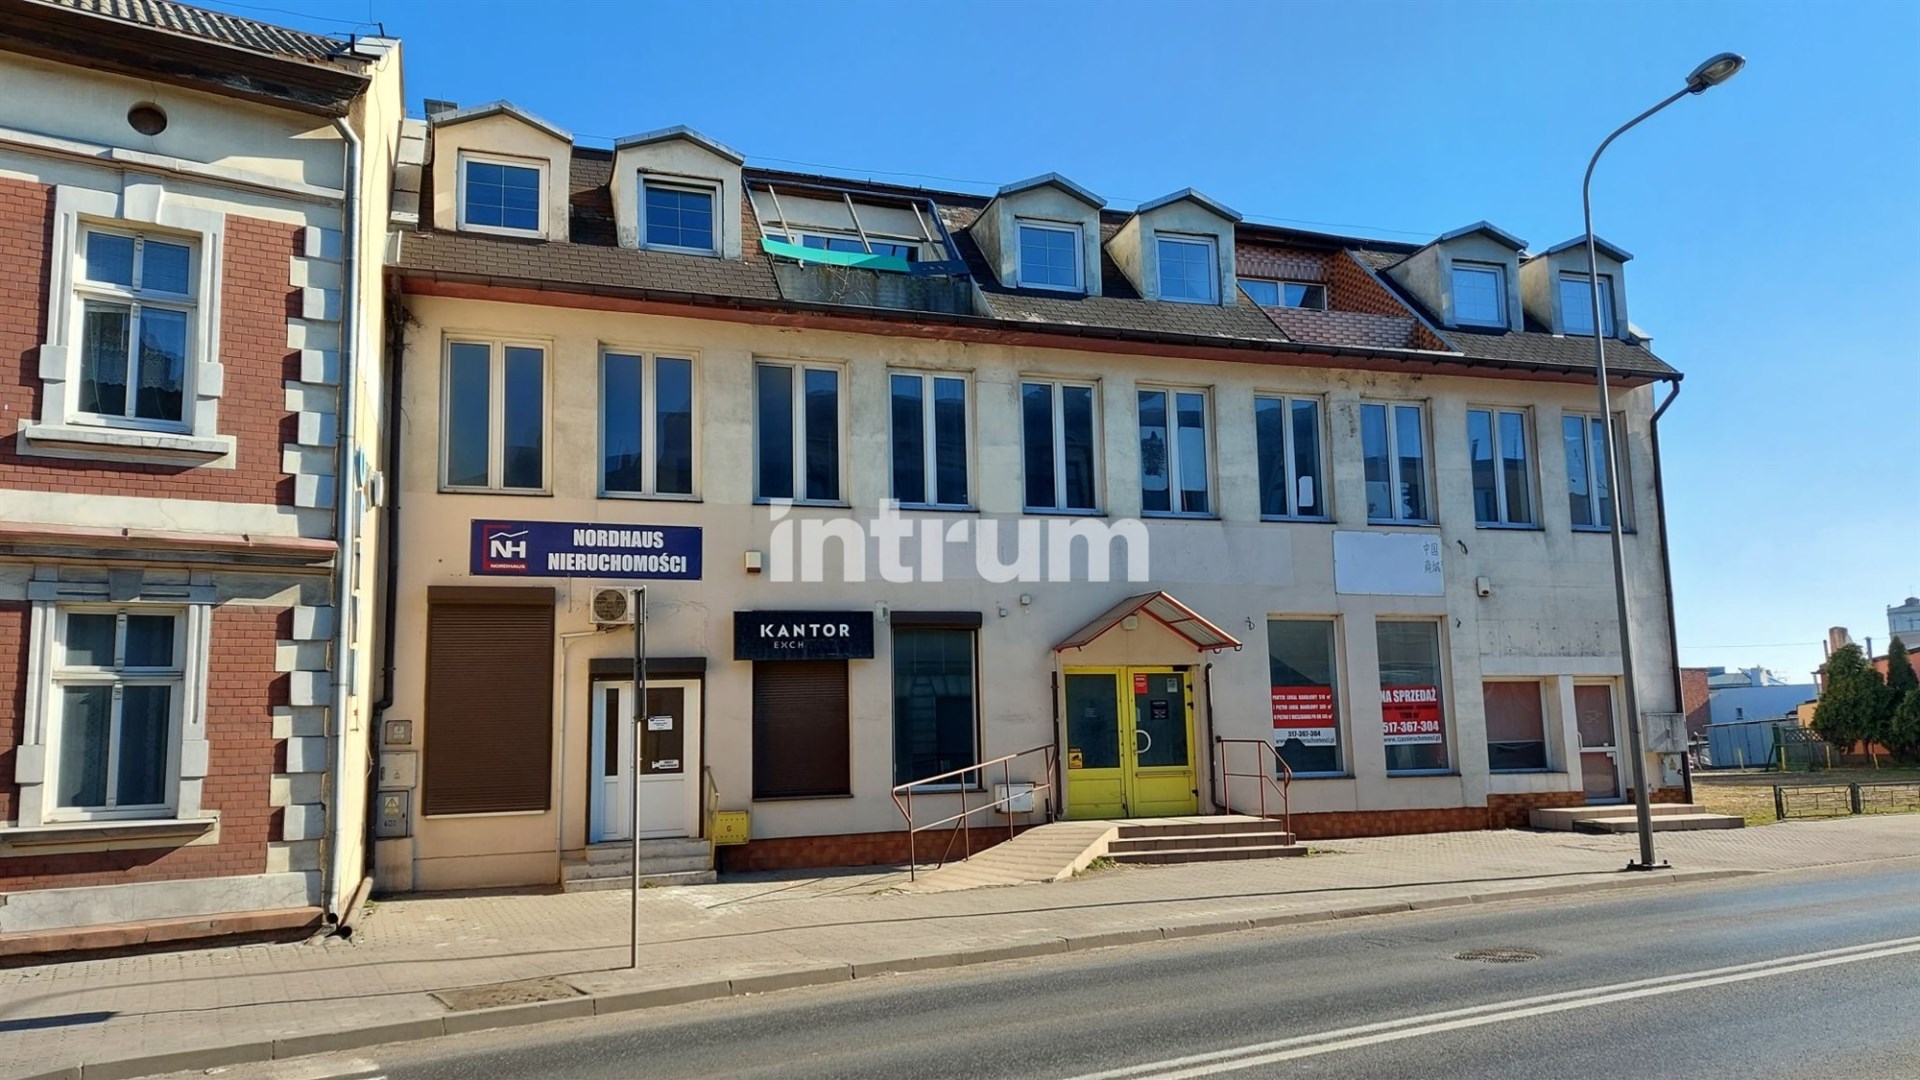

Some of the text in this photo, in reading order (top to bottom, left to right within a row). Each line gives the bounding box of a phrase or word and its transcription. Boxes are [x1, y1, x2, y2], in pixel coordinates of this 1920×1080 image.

[573, 529, 664, 549] NORDHAUS
[490, 540, 526, 559] NH
[547, 552, 687, 573] NIERUCHOMOŚCI
[760, 623, 851, 638] KANTOR
[774, 640, 805, 649] EXCH
[1393, 687, 1436, 702] SPRZEDAŻ
[1383, 721, 1439, 733] 517-367-304
